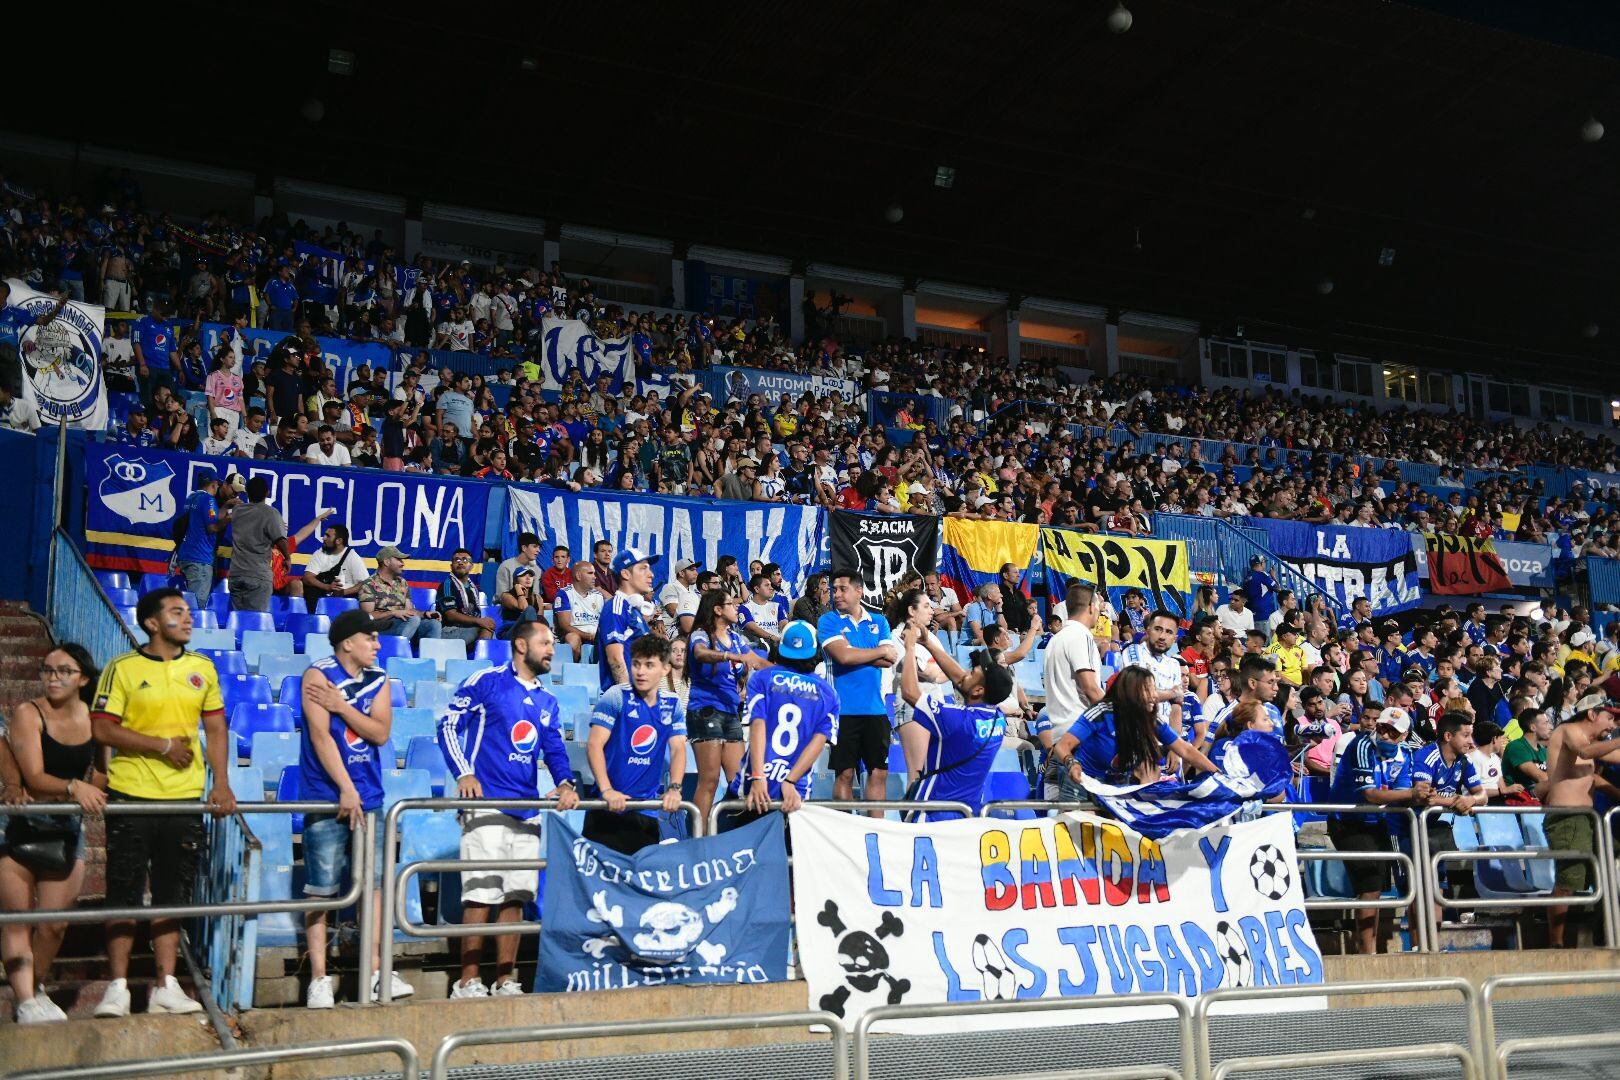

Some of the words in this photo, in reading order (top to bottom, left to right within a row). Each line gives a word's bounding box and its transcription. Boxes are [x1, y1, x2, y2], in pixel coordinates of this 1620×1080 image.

[138, 492, 164, 512] M
[186, 460, 465, 549] CELONA
[1316, 530, 1352, 559] LA
[772, 703, 802, 757] 8
[628, 757, 651, 766] pepsi
[865, 832, 943, 908] LA
[979, 821, 1170, 911] BANDA
[1199, 835, 1232, 912] Y
